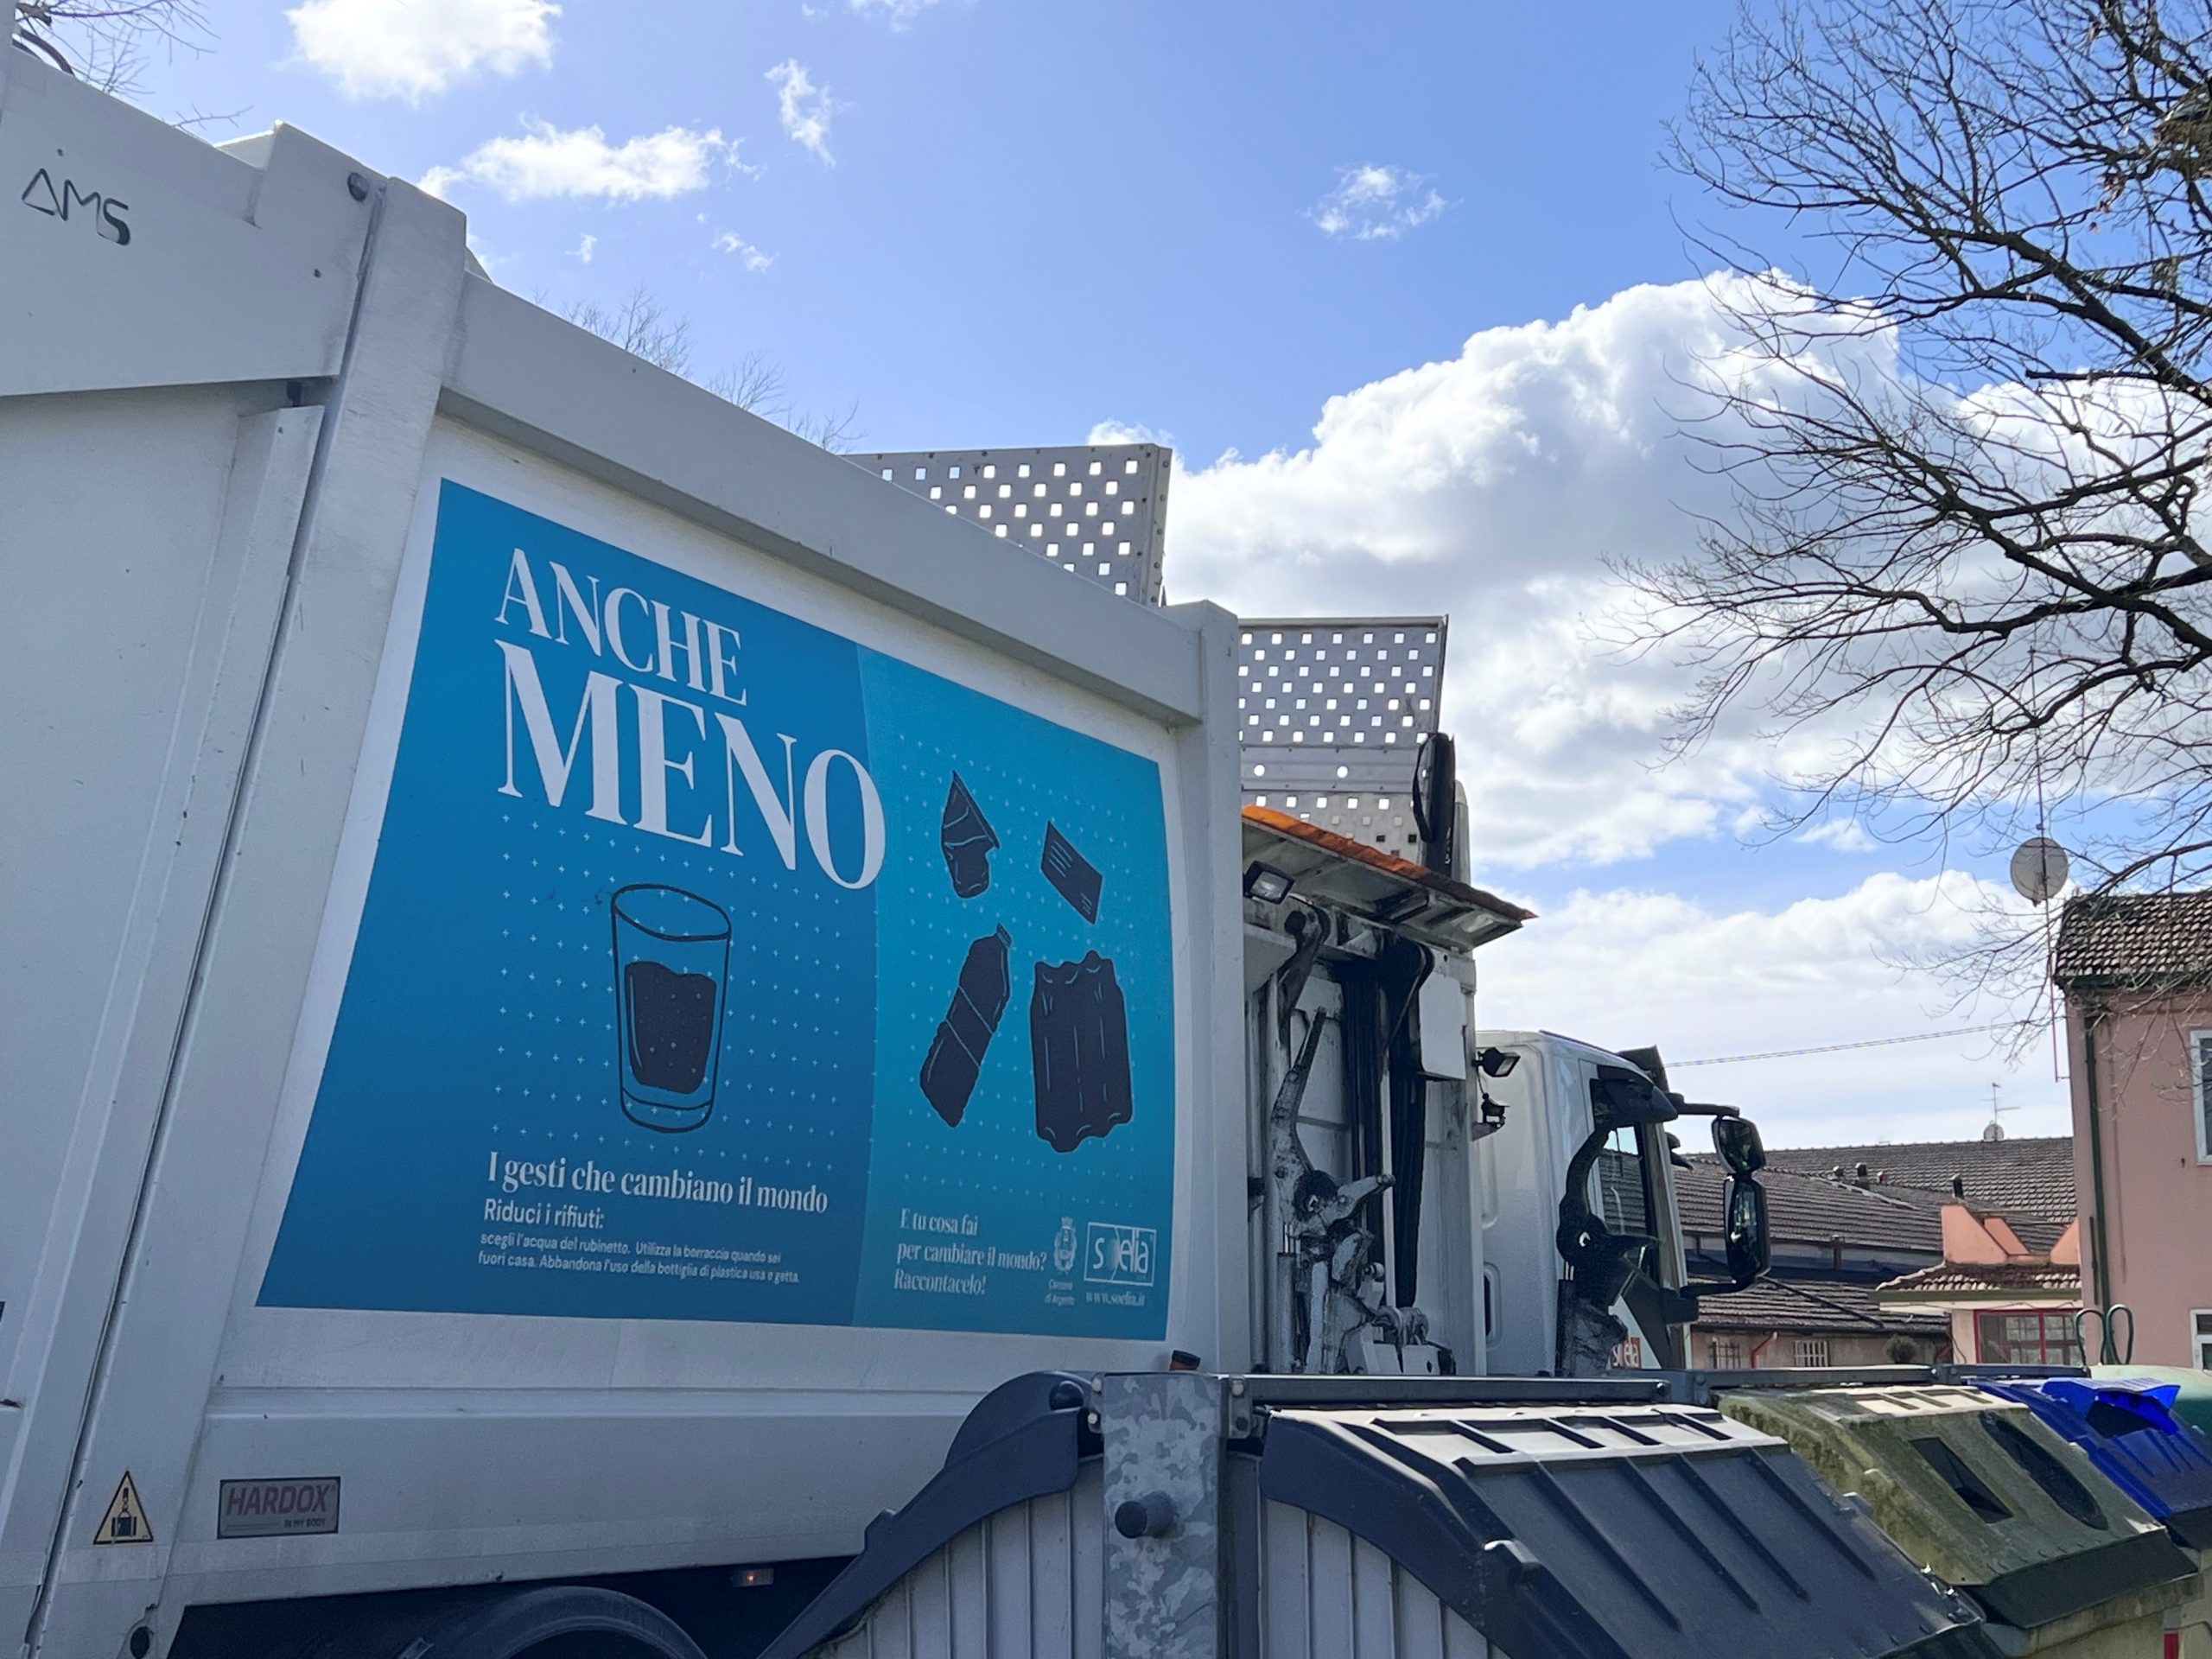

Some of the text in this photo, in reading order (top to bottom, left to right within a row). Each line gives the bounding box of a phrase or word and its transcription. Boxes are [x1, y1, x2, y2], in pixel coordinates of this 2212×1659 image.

[494, 548, 747, 706] ANCHE
[494, 639, 887, 889] MENO
[488, 1151, 828, 1213] I gesti che cambiano il mondo
[484, 1198, 605, 1230] Riduci i rifiuti:
[900, 1208, 979, 1236] E tu cosa fai
[480, 1232, 515, 1249] scegli
[560, 1236, 578, 1250] del
[579, 1238, 631, 1255] rubinetto.
[636, 1241, 671, 1255] Utilizza
[673, 1244, 681, 1257] la
[731, 1250, 766, 1263] quando
[897, 1243, 1047, 1272] per cambiare il mondo?
[479, 1250, 505, 1265] fuori
[539, 1255, 601, 1272] Abbandona
[631, 1260, 656, 1274] della
[658, 1262, 697, 1279] bottiglia
[699, 1264, 709, 1276] di
[710, 1265, 747, 1280] plastica
[749, 1271, 766, 1281] usa
[767, 1273, 773, 1281] e
[893, 1268, 987, 1295] Raccontacelo!
[226, 1484, 329, 1516] HARDOX
